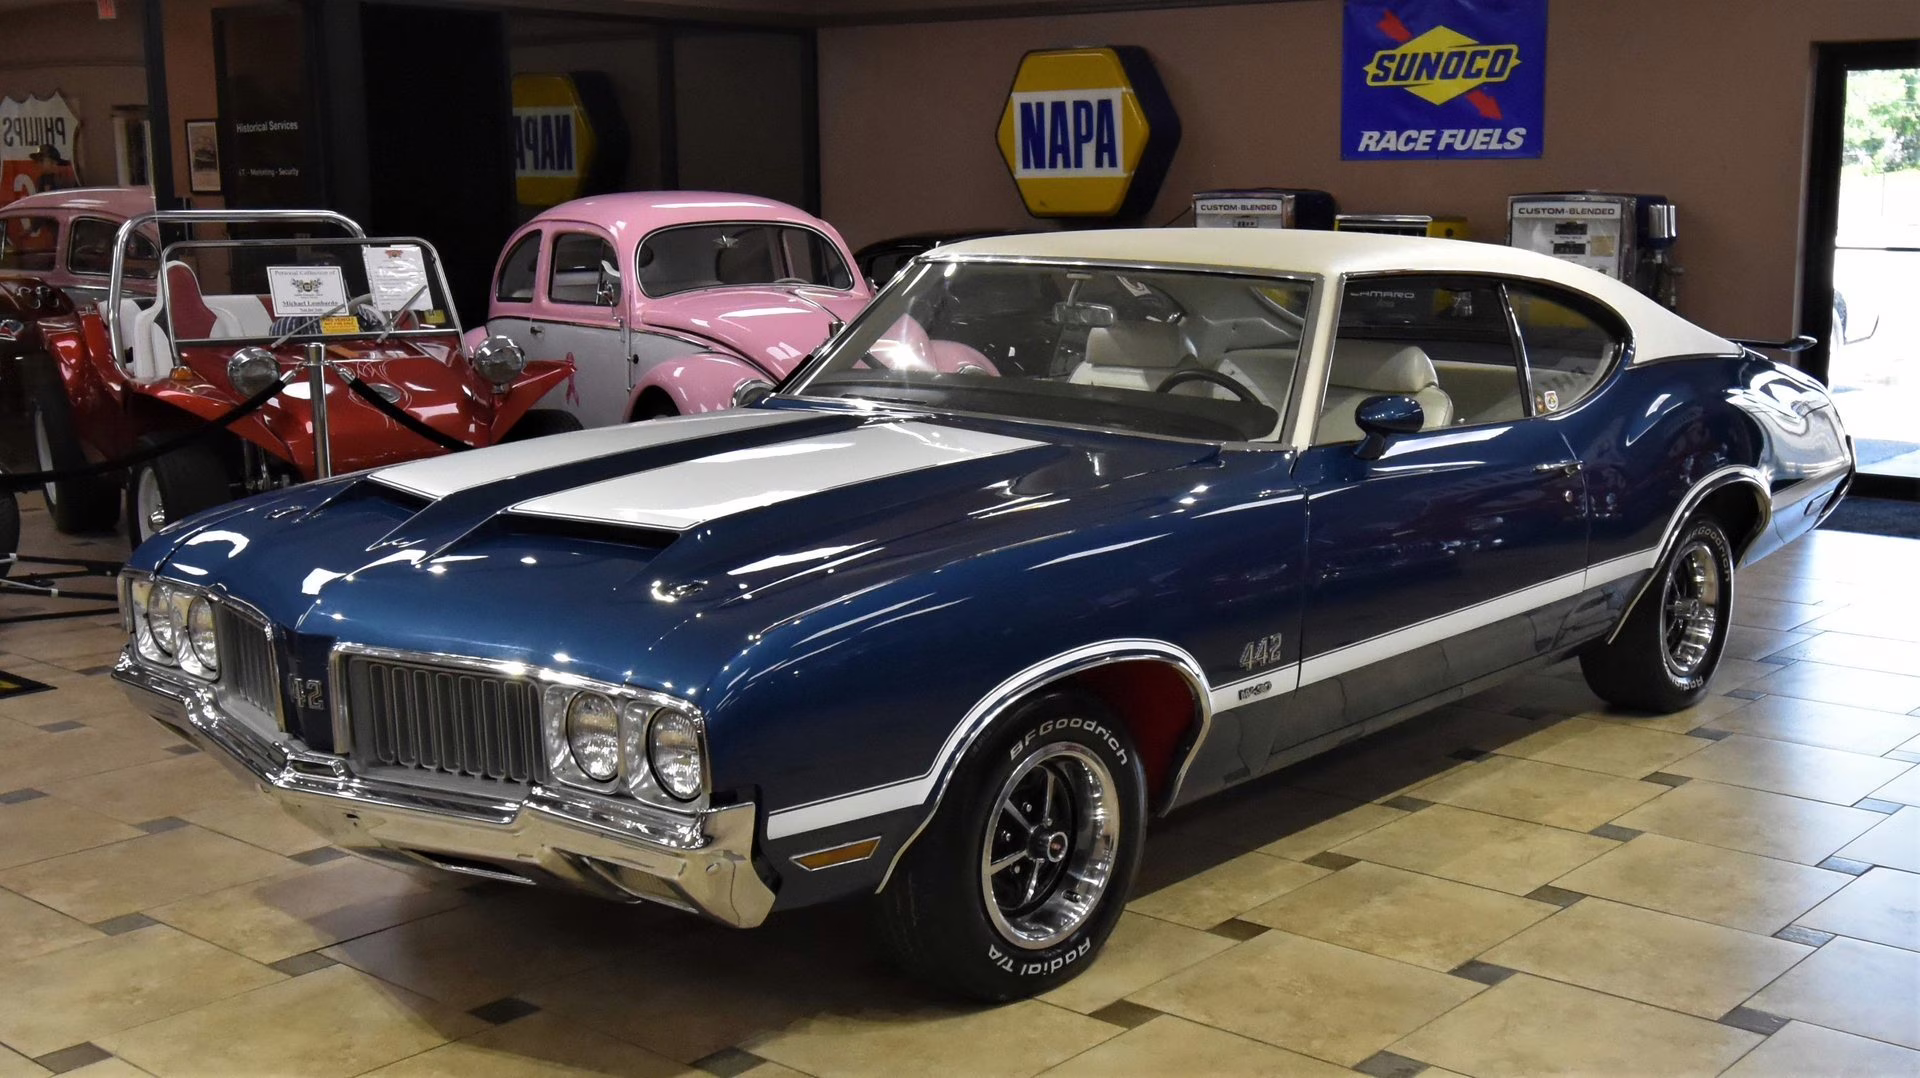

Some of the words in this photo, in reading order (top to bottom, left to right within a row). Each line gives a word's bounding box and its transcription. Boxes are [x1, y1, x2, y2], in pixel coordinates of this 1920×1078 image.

[1370, 49, 1514, 83] SUNOCO
[236, 122, 268, 133] Historical
[268, 120, 298, 131] Services
[1020, 98, 1118, 170] NAPA
[1358, 130, 1436, 152] RACE
[1437, 127, 1527, 151] FUELS
[1240, 632, 1282, 671] 442
[1009, 717, 1128, 766] BFGoodrich
[988, 944, 1013, 974] T/A
[1020, 937, 1091, 976] Radial
